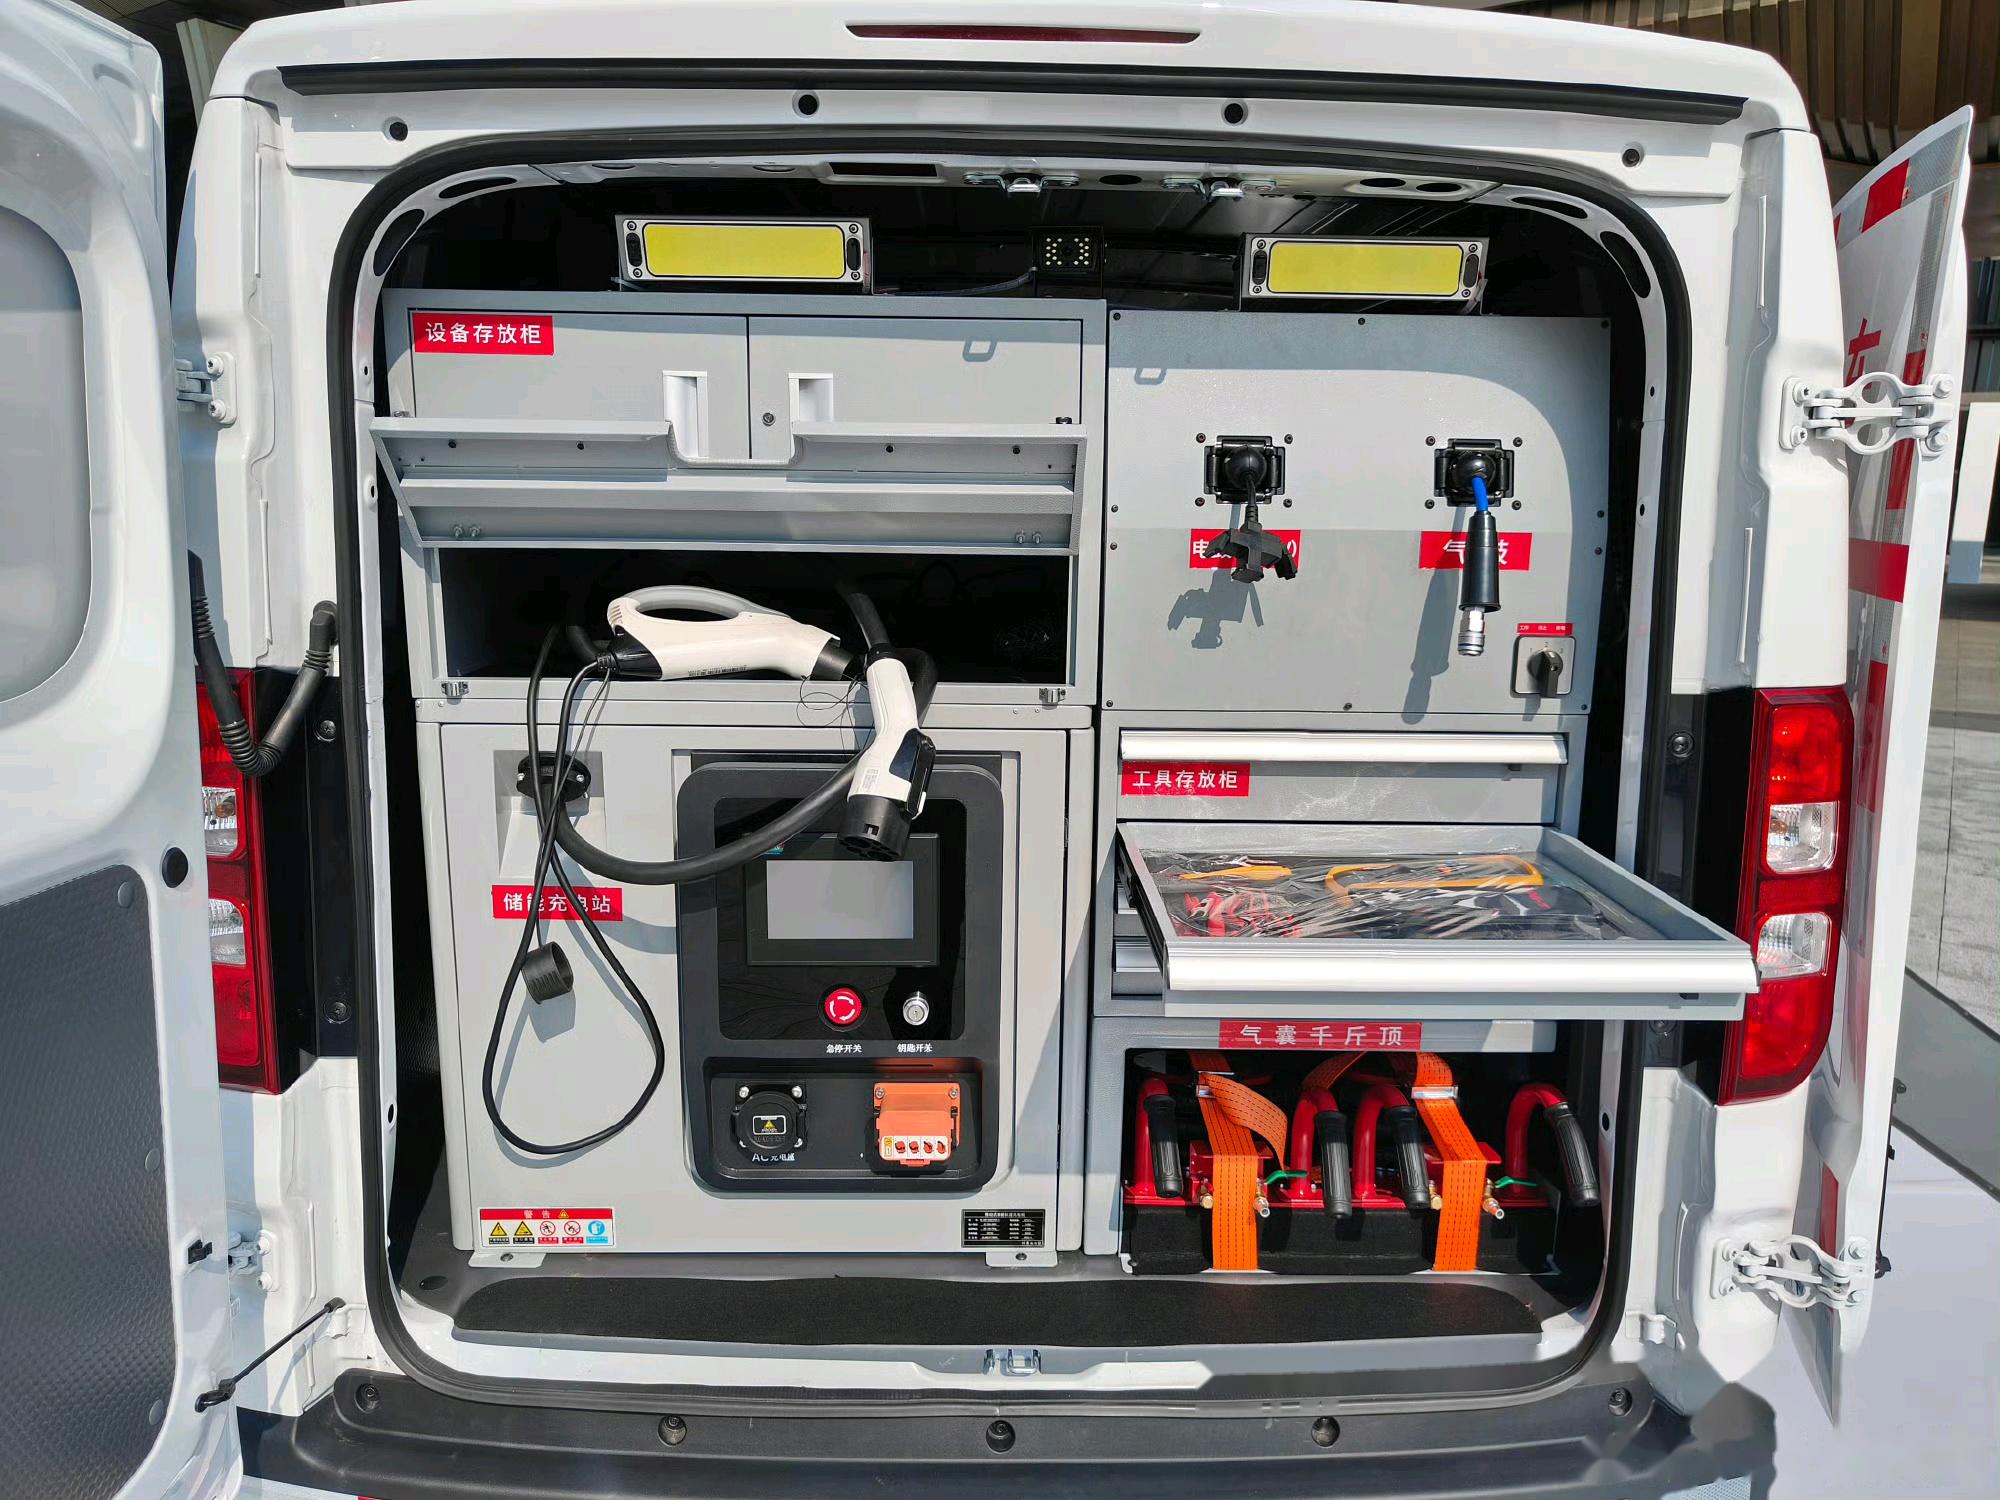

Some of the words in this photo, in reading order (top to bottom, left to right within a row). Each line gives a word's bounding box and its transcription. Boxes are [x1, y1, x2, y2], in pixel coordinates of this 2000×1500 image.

[425, 321, 542, 345] 设备存放柜
[1132, 769, 1238, 789] 工具存放柜
[1240, 1024, 1403, 1046] 气囊千斤顶
[826, 1043, 863, 1053] 急停开关
[897, 1043, 933, 1053] 钥匙开关
